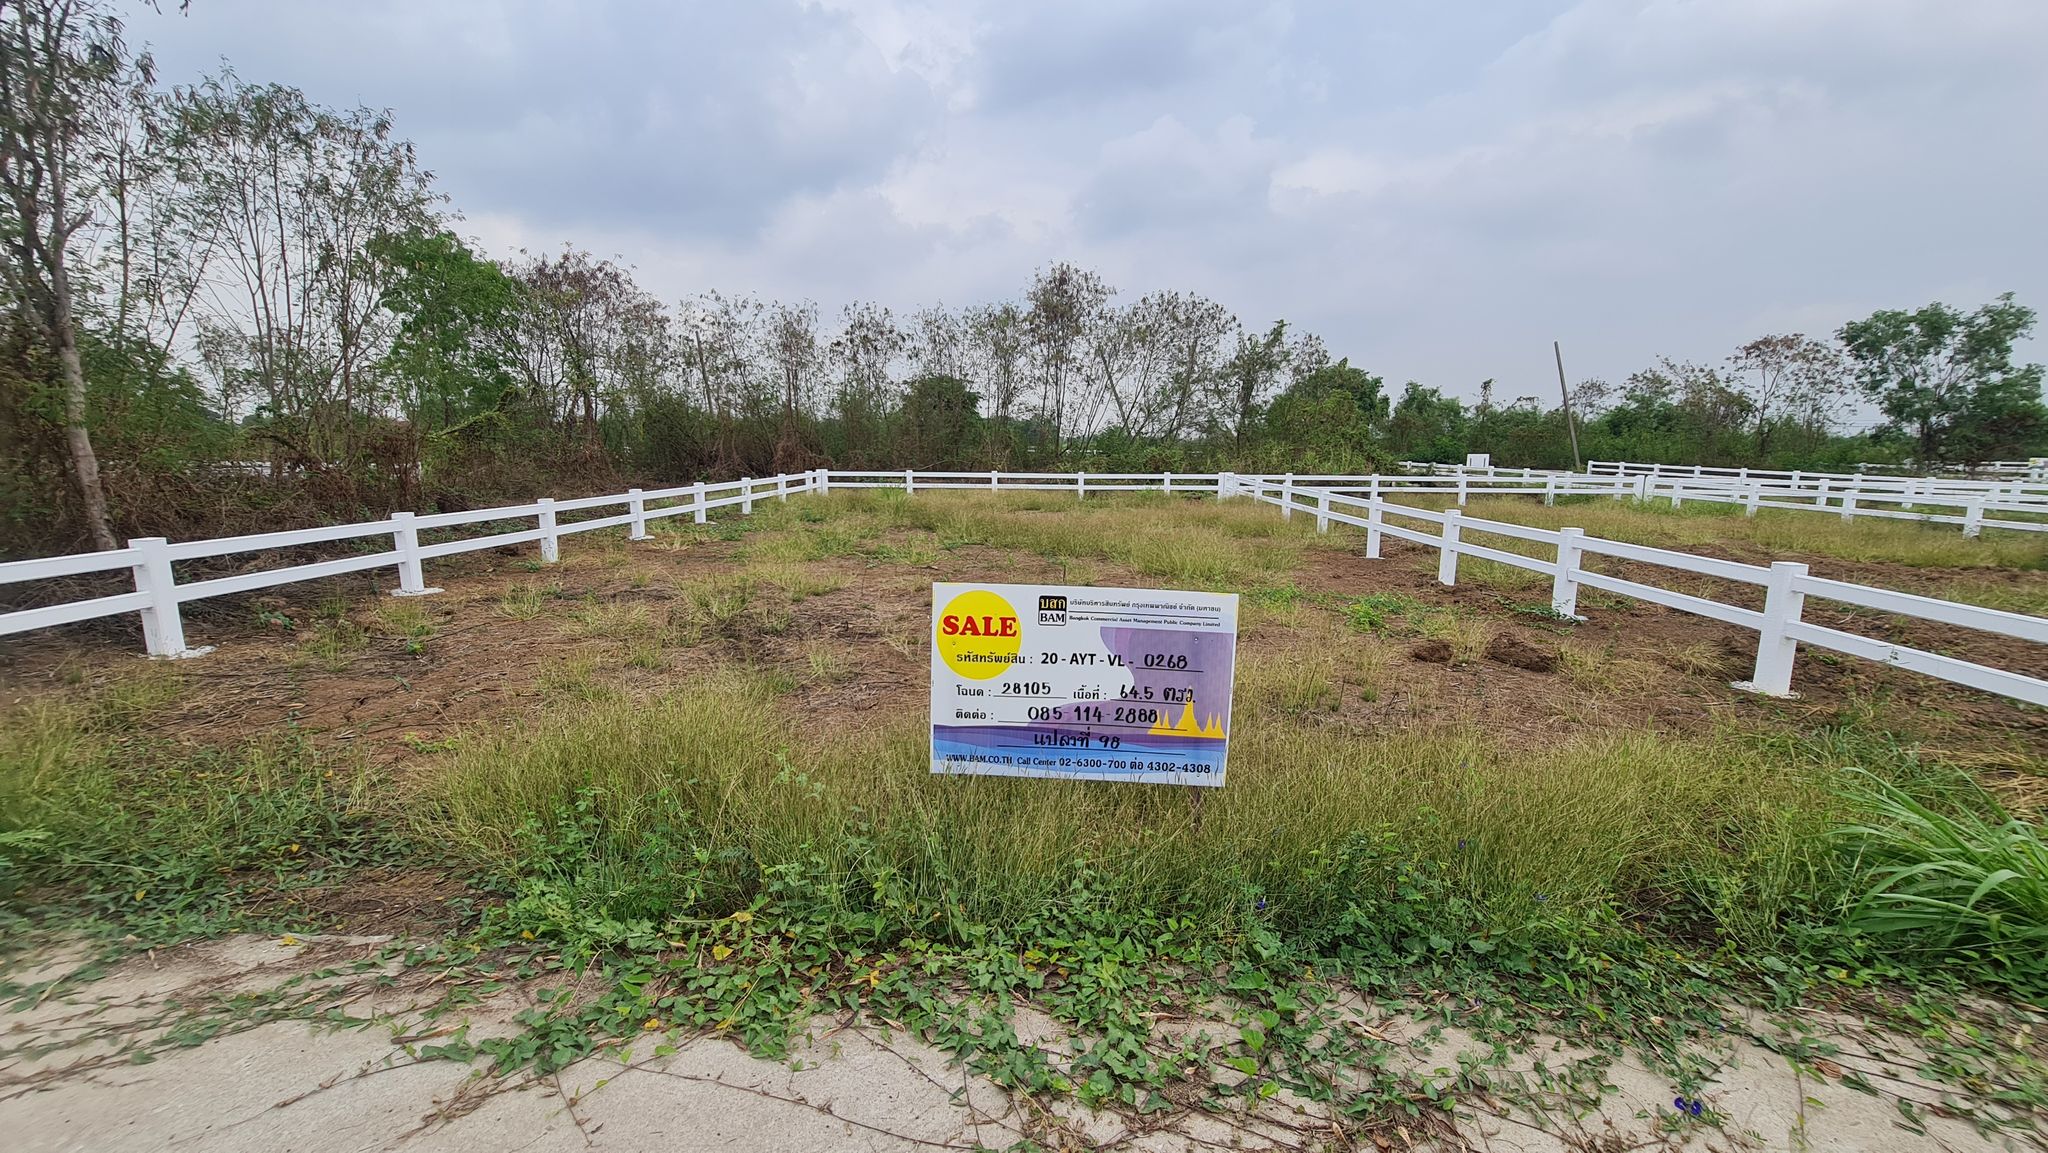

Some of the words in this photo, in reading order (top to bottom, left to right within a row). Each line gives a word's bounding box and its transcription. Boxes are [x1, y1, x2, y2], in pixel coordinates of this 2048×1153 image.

[1040, 598, 1066, 610] บสก
[1040, 612, 1065, 623] BAM
[942, 615, 1017, 637] SALE
[956, 651, 1026, 664] รหัสทรัพย์สิน
[1040, 652, 1058, 665] 20
[1069, 653, 1097, 666] AYT
[1107, 654, 1125, 667] VL
[1143, 654, 1188, 669] 0268
[956, 684, 984, 697] โฉนด
[1001, 682, 1051, 695] 28105
[1073, 684, 1100, 700] เนื้อที่
[1120, 684, 1154, 700] 64.5
[955, 708, 987, 720] ติดต่อ
[1098, 735, 1121, 749] 98
[1017, 756, 1031, 766] Call
[1032, 758, 1057, 767] Center
[1059, 757, 1127, 770] 02-6300-700
[1129, 756, 1144, 770] ต่อ
[1147, 761, 1211, 774] 4302-4308
